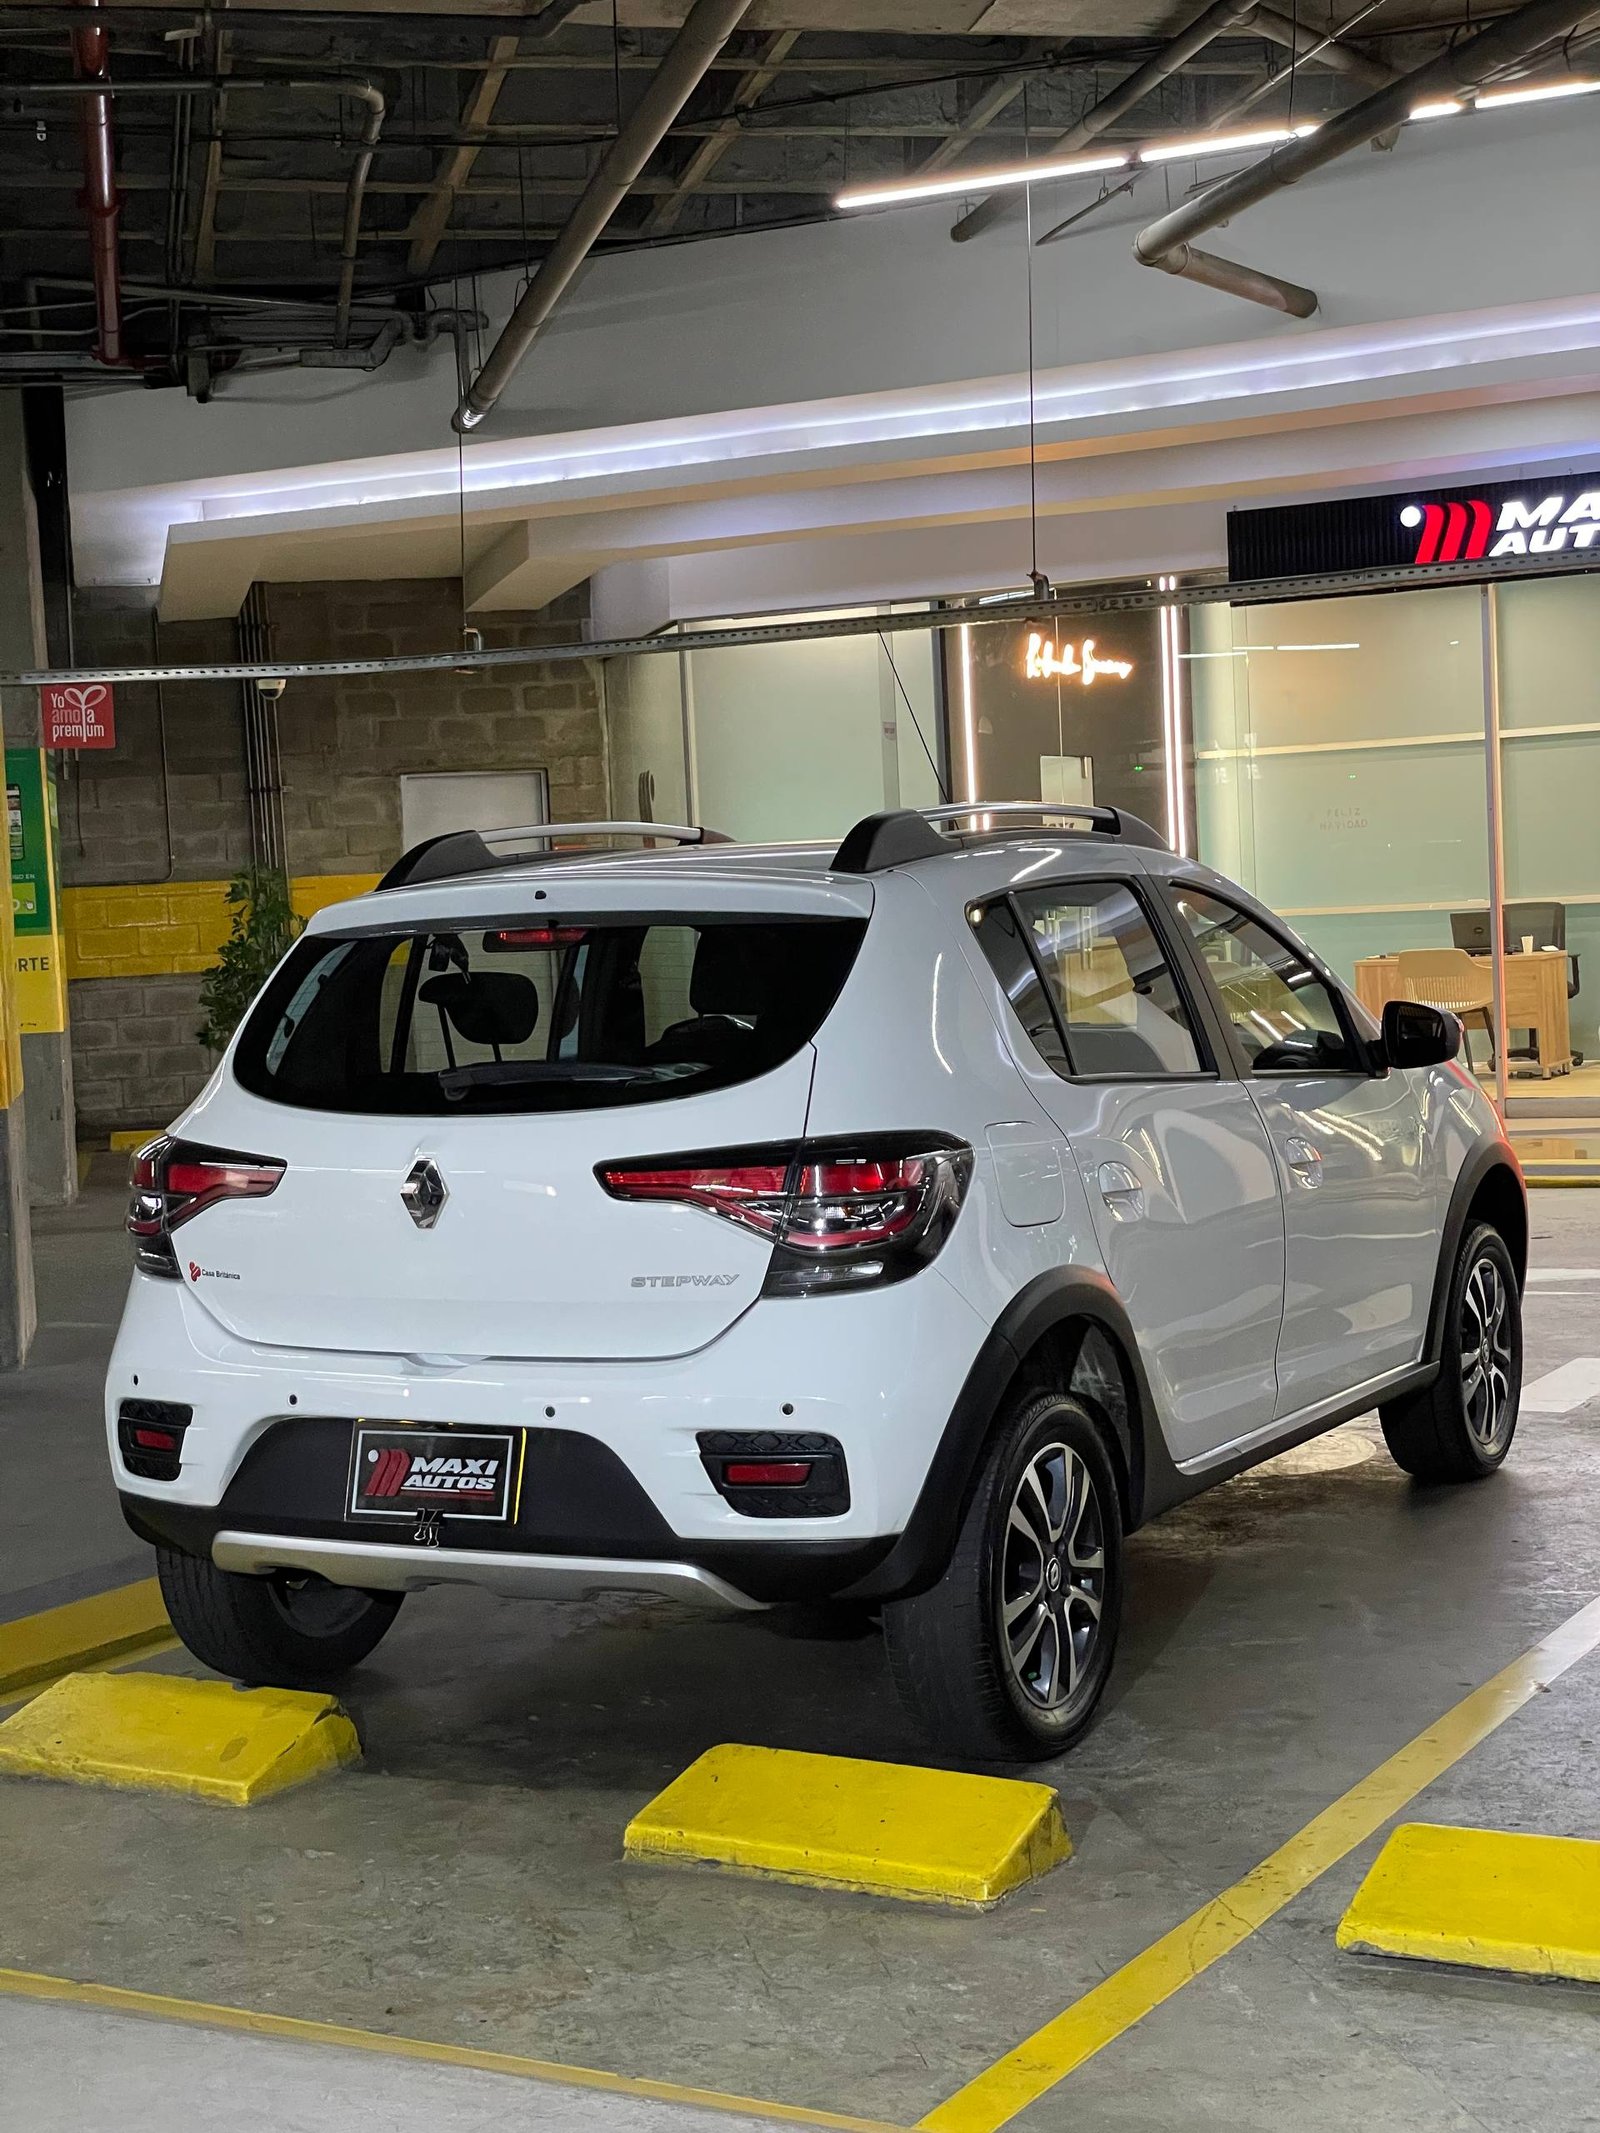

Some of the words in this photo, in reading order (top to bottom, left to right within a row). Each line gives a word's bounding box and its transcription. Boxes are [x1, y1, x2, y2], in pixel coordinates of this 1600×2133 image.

[1496, 491, 1600, 531] MA
[1488, 523, 1600, 557] AUT
[51, 693, 65, 708] Yo
[52, 709, 80, 724] amo
[52, 724, 105, 742] premium
[15, 956, 50, 972] RTE
[201, 1269, 215, 1277] Casa
[630, 1273, 740, 1288] STEPWAY
[410, 1456, 499, 1476] MAXI
[403, 1474, 496, 1490] AUTOS
